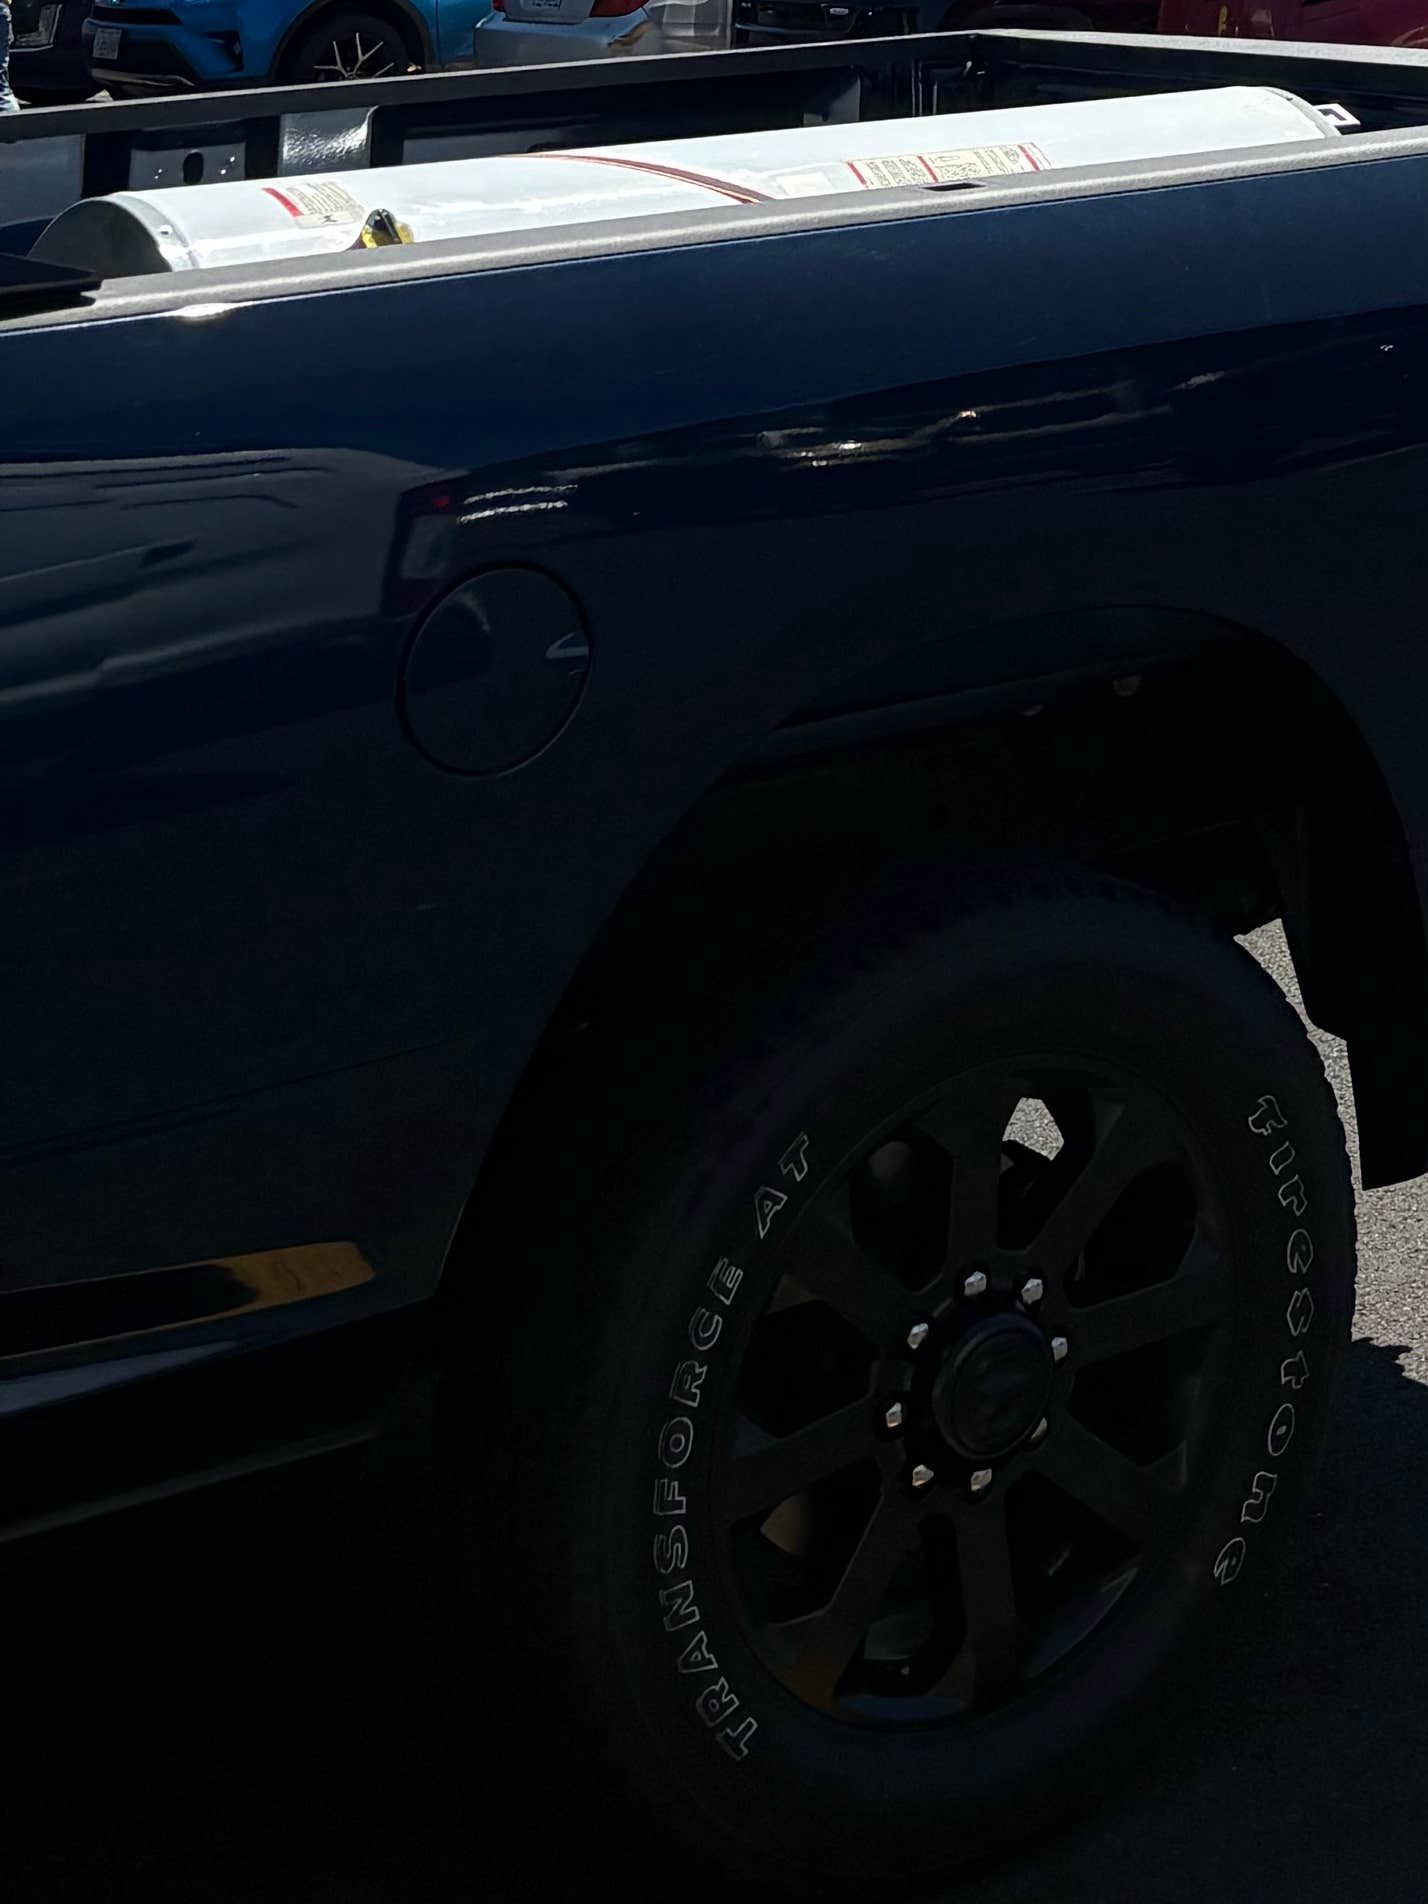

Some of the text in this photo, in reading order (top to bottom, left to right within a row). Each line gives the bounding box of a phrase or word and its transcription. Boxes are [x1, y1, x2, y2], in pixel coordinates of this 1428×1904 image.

[653, 1130, 811, 1761] TRANSFORCE AT
[1213, 1094, 1314, 1585] Firestone
